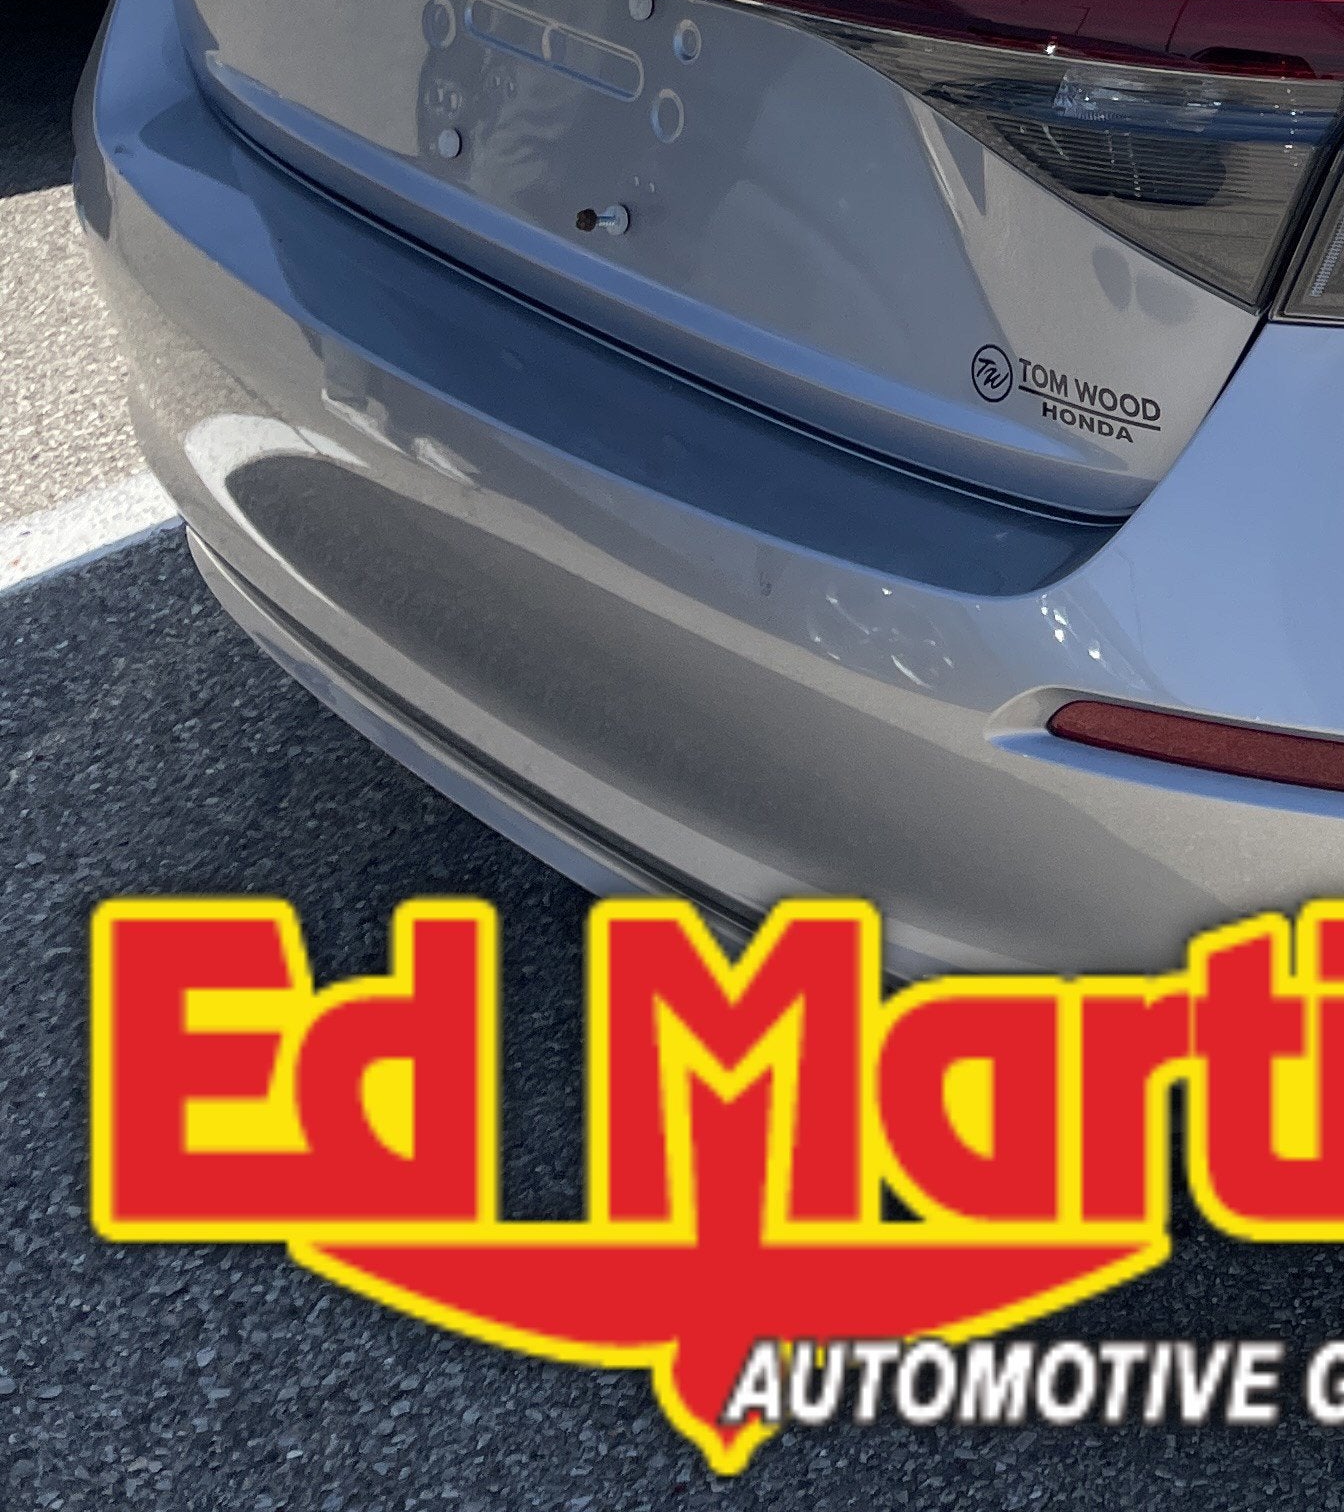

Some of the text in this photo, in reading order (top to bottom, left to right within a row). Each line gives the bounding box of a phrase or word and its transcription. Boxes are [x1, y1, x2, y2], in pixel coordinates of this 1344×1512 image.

[1019, 357, 1161, 422] TOM WOOD
[1042, 401, 1134, 444] HONDA
